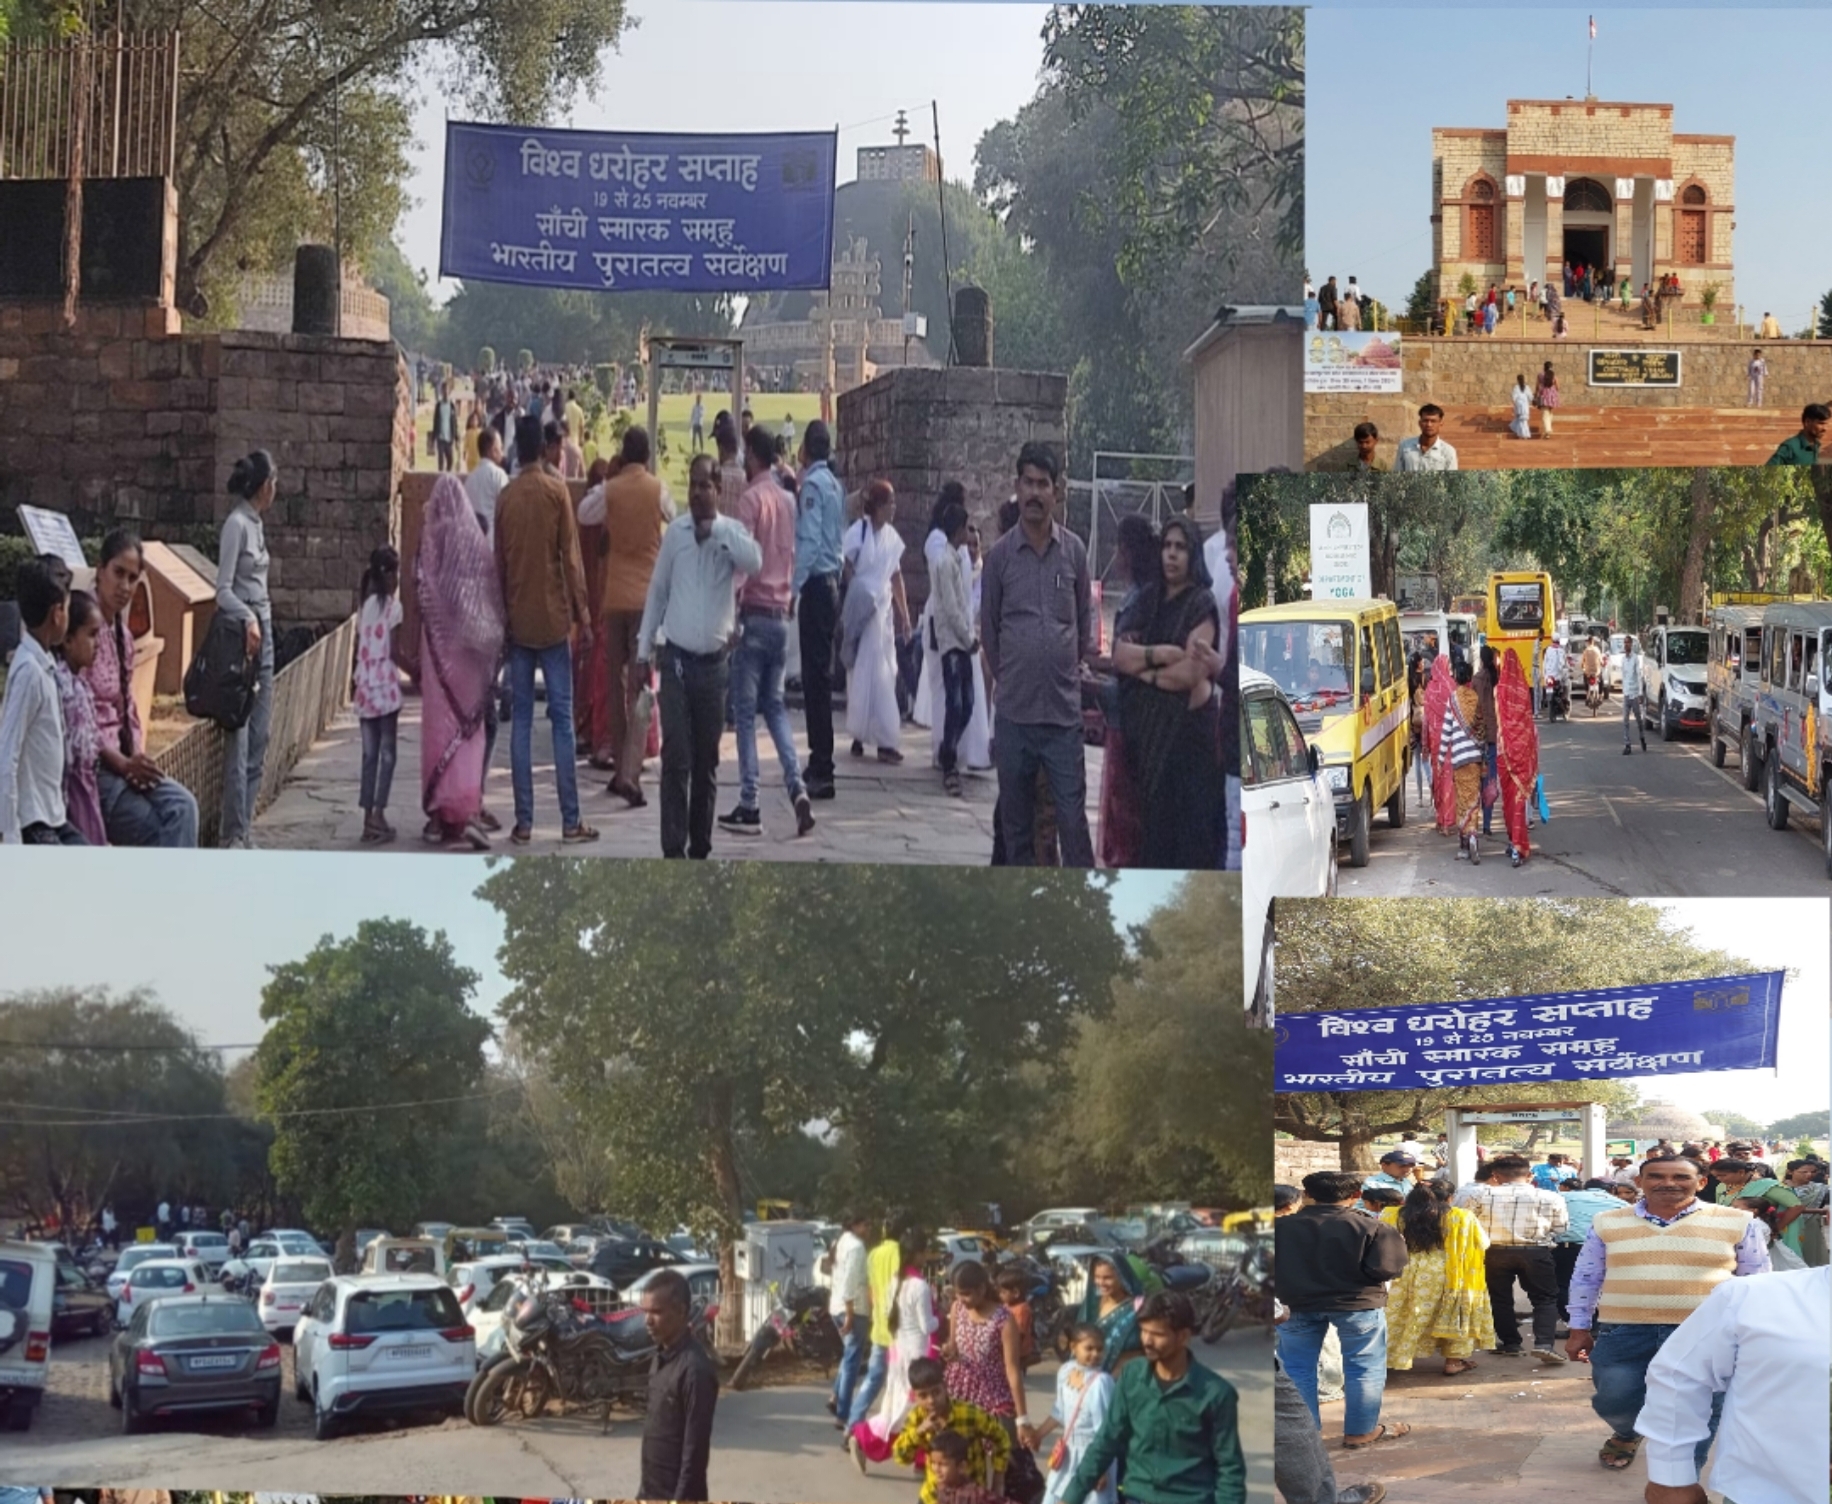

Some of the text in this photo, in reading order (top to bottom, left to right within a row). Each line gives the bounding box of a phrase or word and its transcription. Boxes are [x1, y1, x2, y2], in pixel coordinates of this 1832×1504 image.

[519, 138, 762, 191] विश्व धरोहर सप्ताह
[594, 187, 708, 209] 19 से 25 नवम्बर
[598, 217, 671, 241] स्मारक
[490, 240, 788, 286] भारतीय पुरातत्व सर्वेक्षण
[1317, 996, 1659, 1038] विश्व धरोहर सप्ताह
[1415, 1026, 1577, 1046] 19 से 25 नवम्बर
[1283, 1050, 1704, 1087] भारतीय पुरातत्व सर्वेक्षण
[1421, 1045, 1523, 1063] स्मारक
